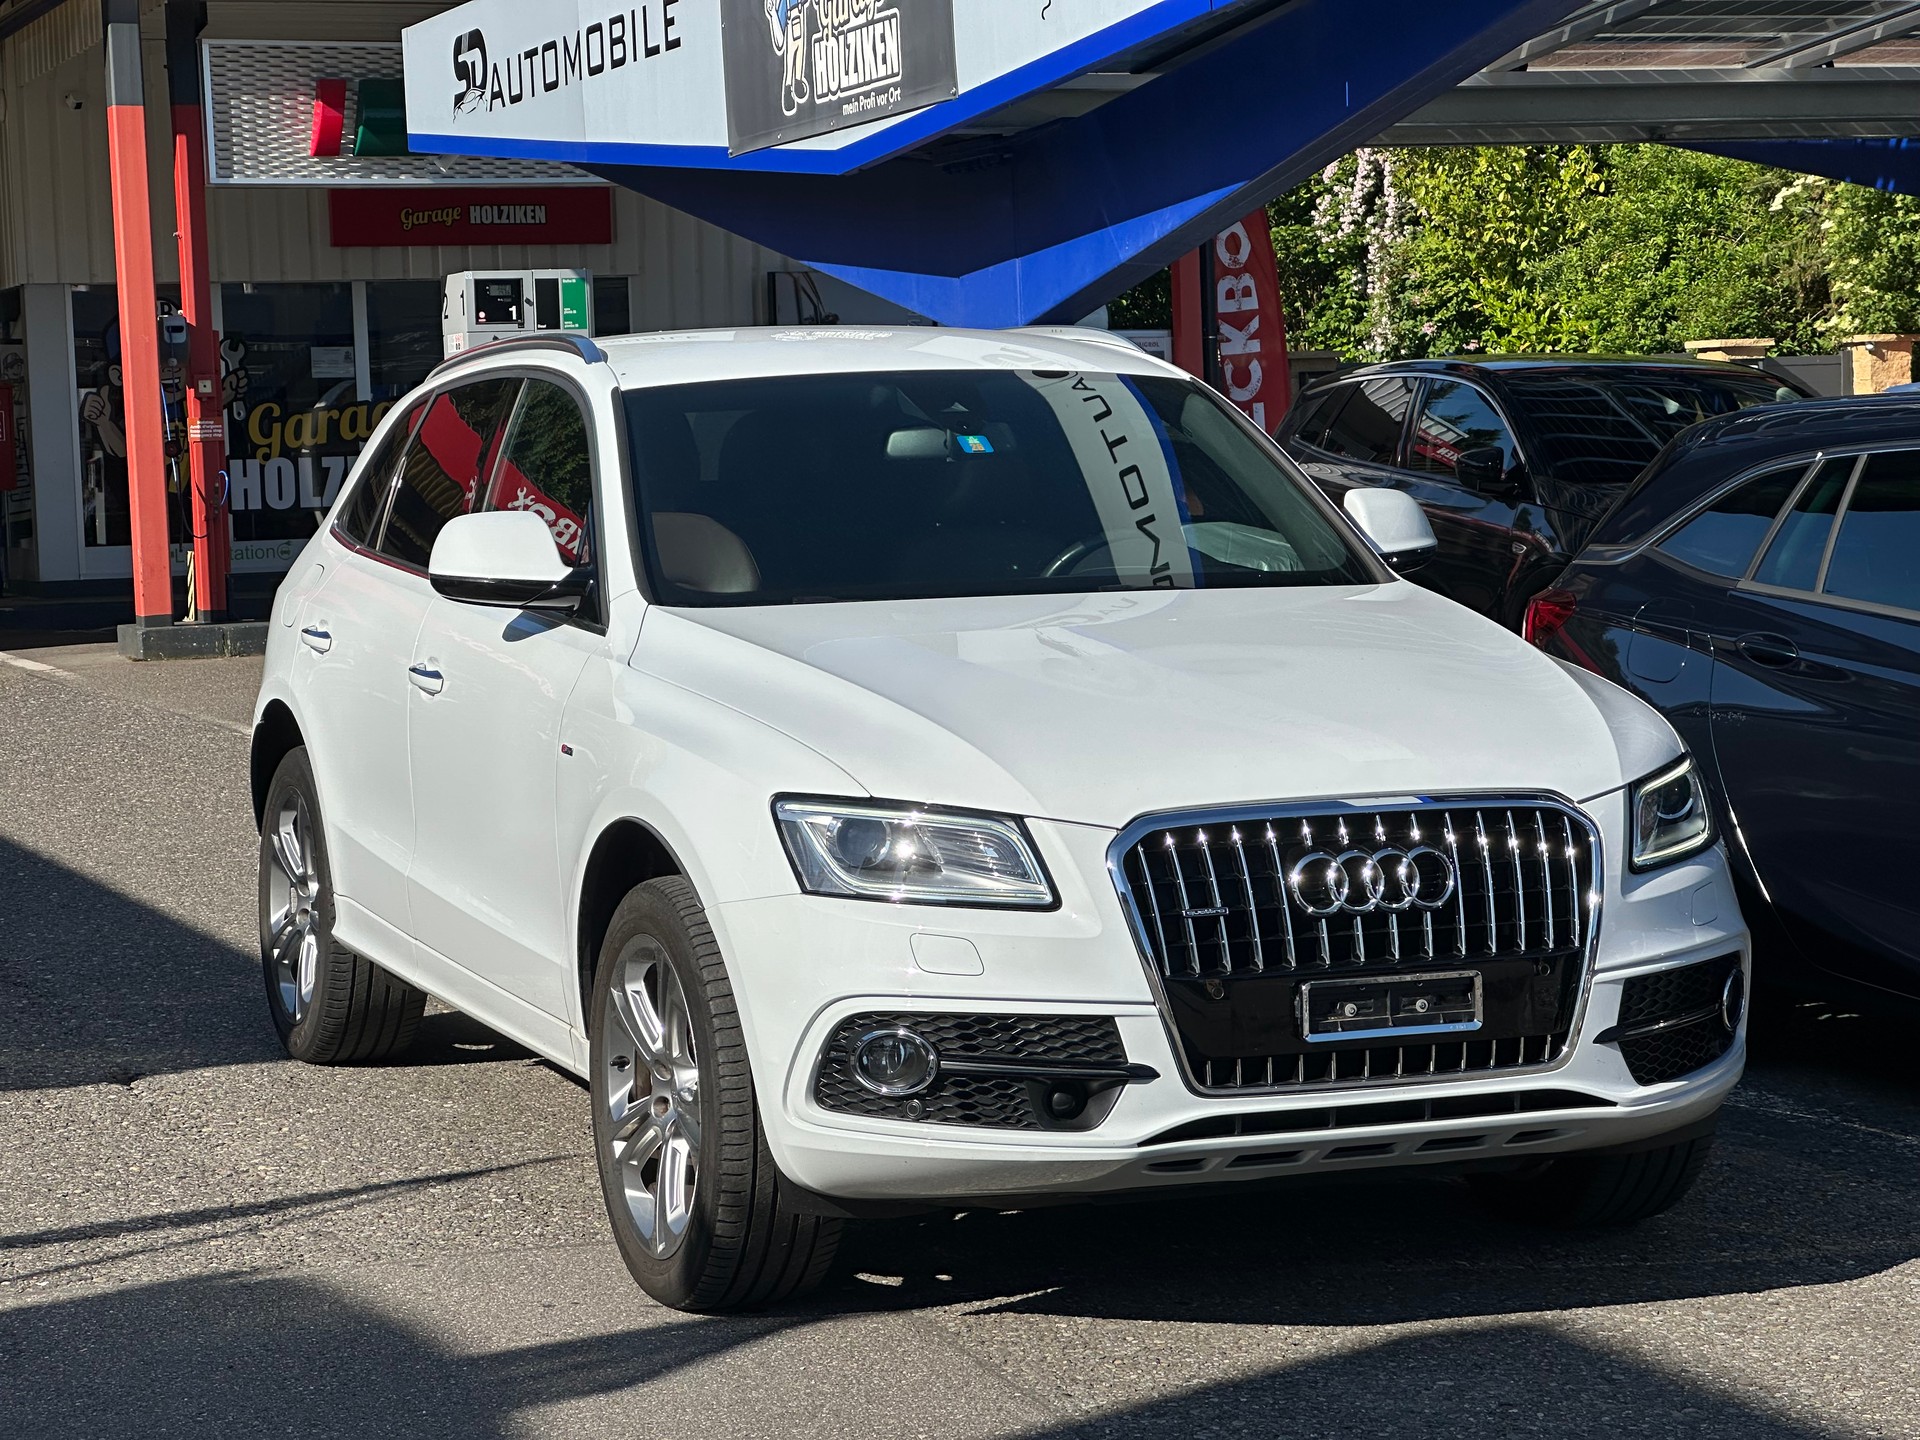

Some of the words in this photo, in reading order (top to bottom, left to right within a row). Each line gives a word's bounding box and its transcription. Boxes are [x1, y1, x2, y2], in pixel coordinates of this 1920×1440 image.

[488, 0, 682, 112] AUTOMOBILE
[815, 17, 898, 95] HOLZIKEN
[842, 98, 859, 116] mein
[859, 92, 876, 111] Profi
[876, 94, 888, 106] vor
[889, 87, 901, 104] Ort
[400, 206, 462, 231] Garage
[468, 205, 546, 225] HOLZIKEN
[508, 305, 517, 320] 1
[229, 456, 358, 511] HOLZ
